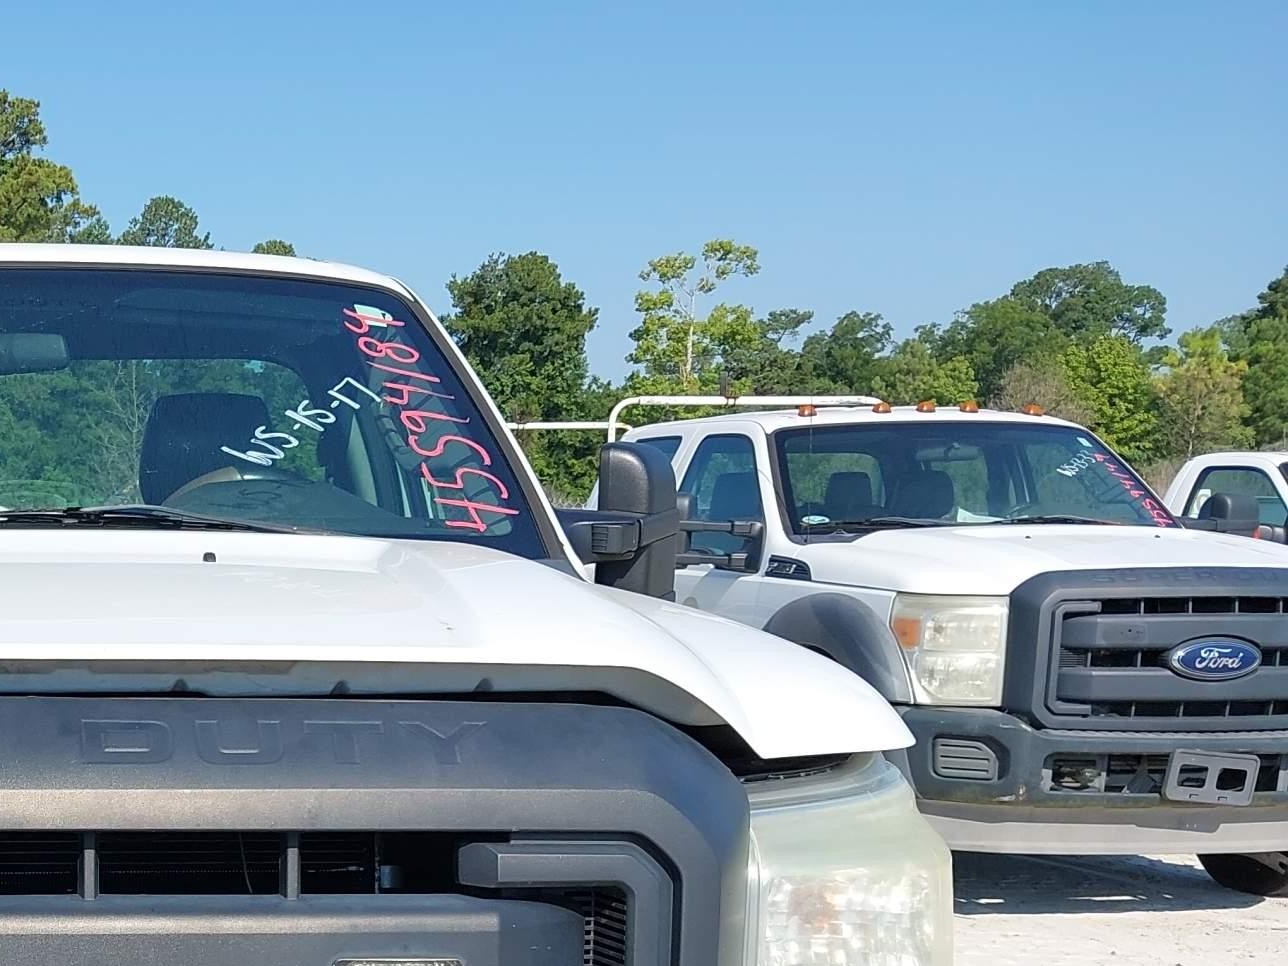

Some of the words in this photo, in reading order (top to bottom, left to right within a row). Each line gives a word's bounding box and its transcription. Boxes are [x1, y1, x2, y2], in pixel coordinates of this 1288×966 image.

[343, 308, 520, 532] 45594184
[1195, 647, 1244, 669] Ford
[80, 718, 488, 765] DUTY
